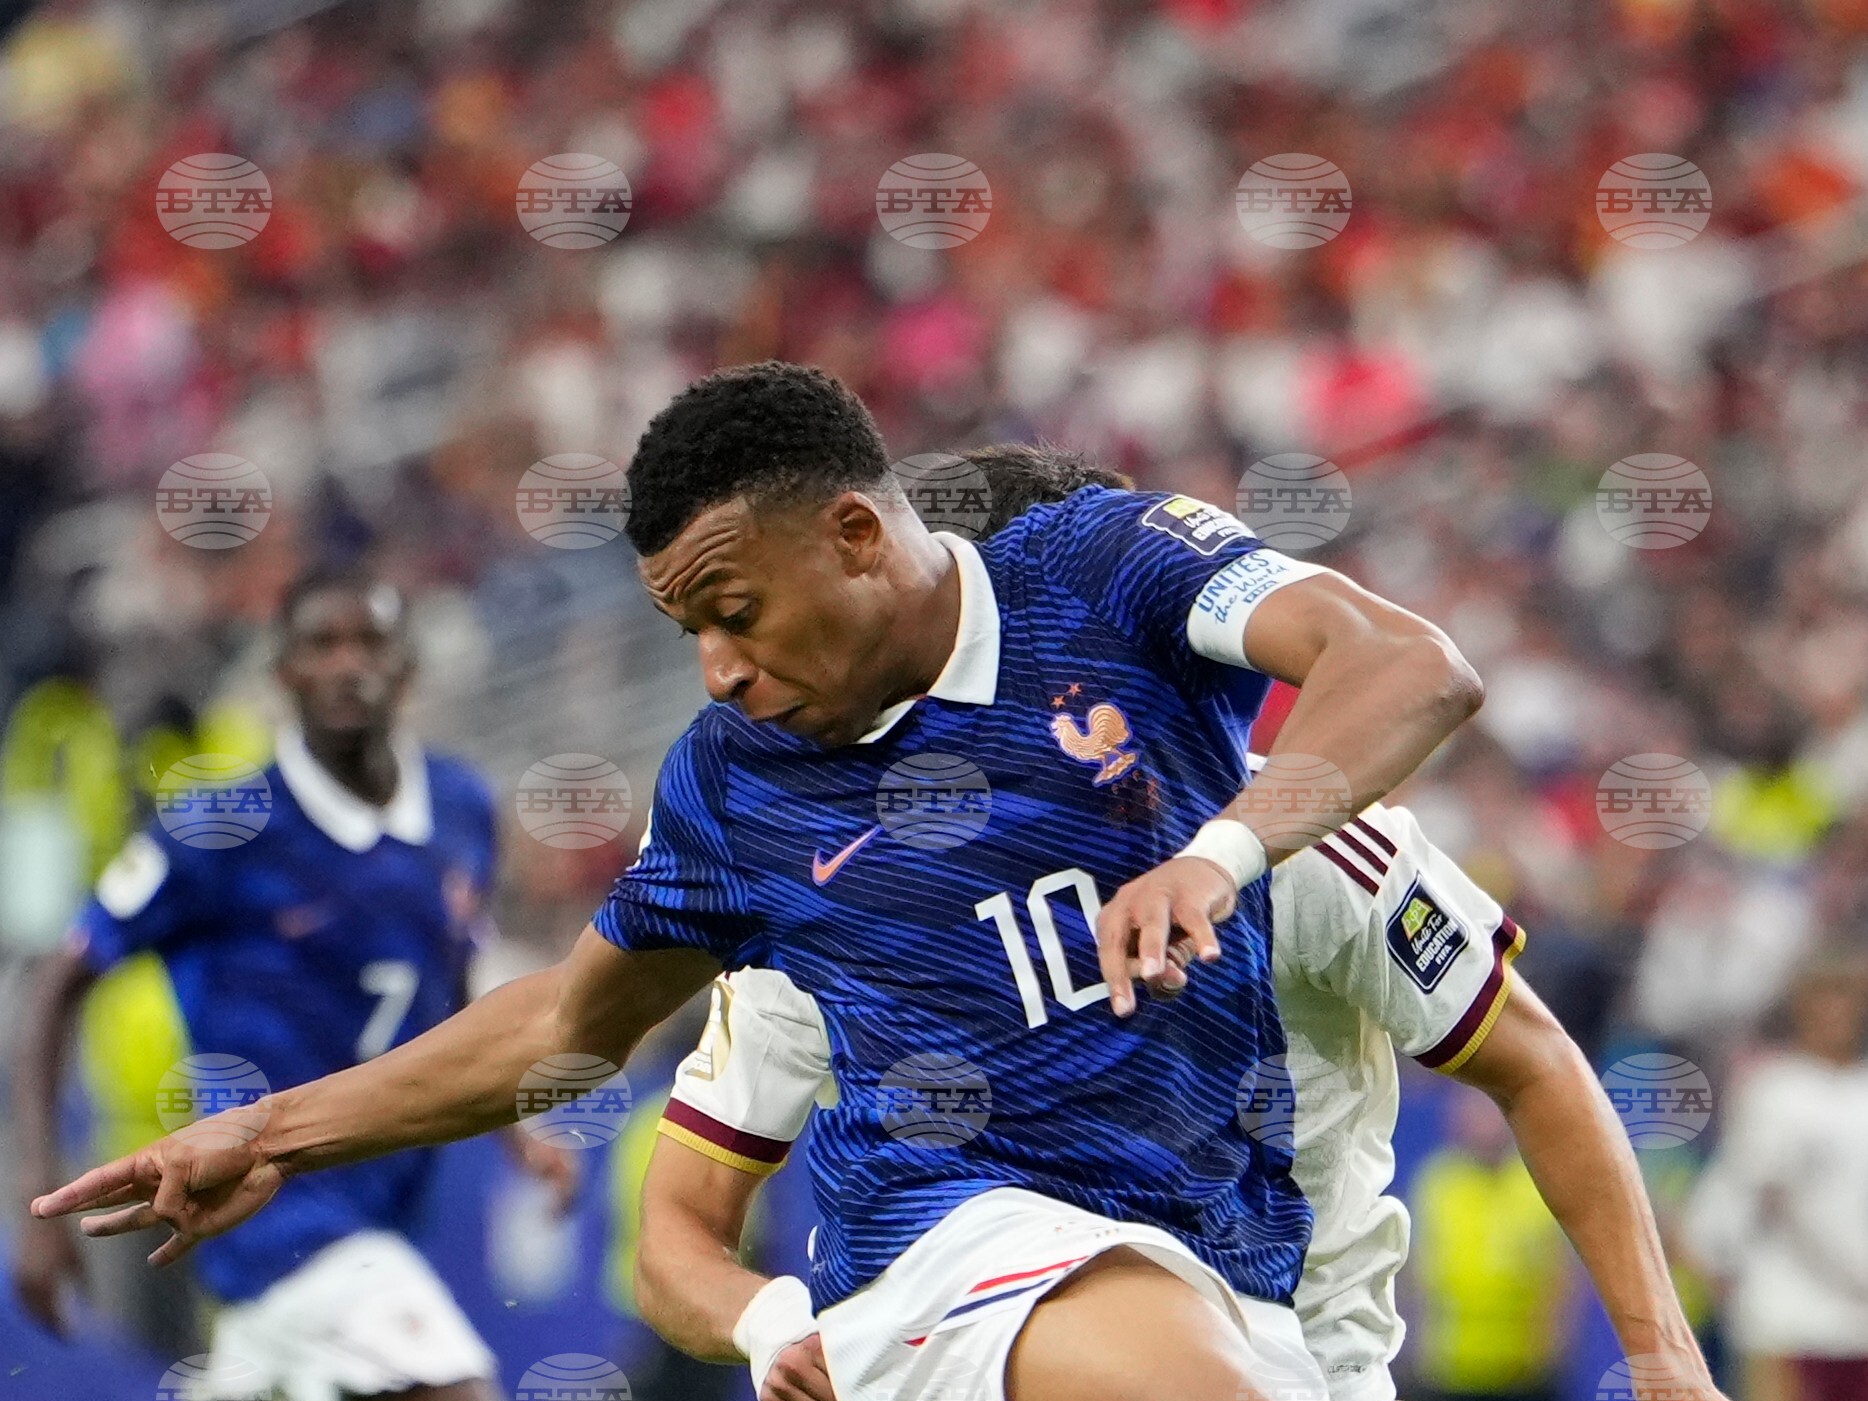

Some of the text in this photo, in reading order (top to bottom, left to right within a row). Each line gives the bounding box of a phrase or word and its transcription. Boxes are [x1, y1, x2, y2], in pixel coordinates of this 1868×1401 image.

[1199, 552, 1269, 613] UNITES
[1214, 594, 1238, 624] the
[1235, 565, 1289, 593] World
[974, 867, 1111, 1029] 10
[1415, 918, 1459, 972] EDUCATION
[1435, 944, 1453, 965] FIFA
[357, 960, 420, 1063] 7
